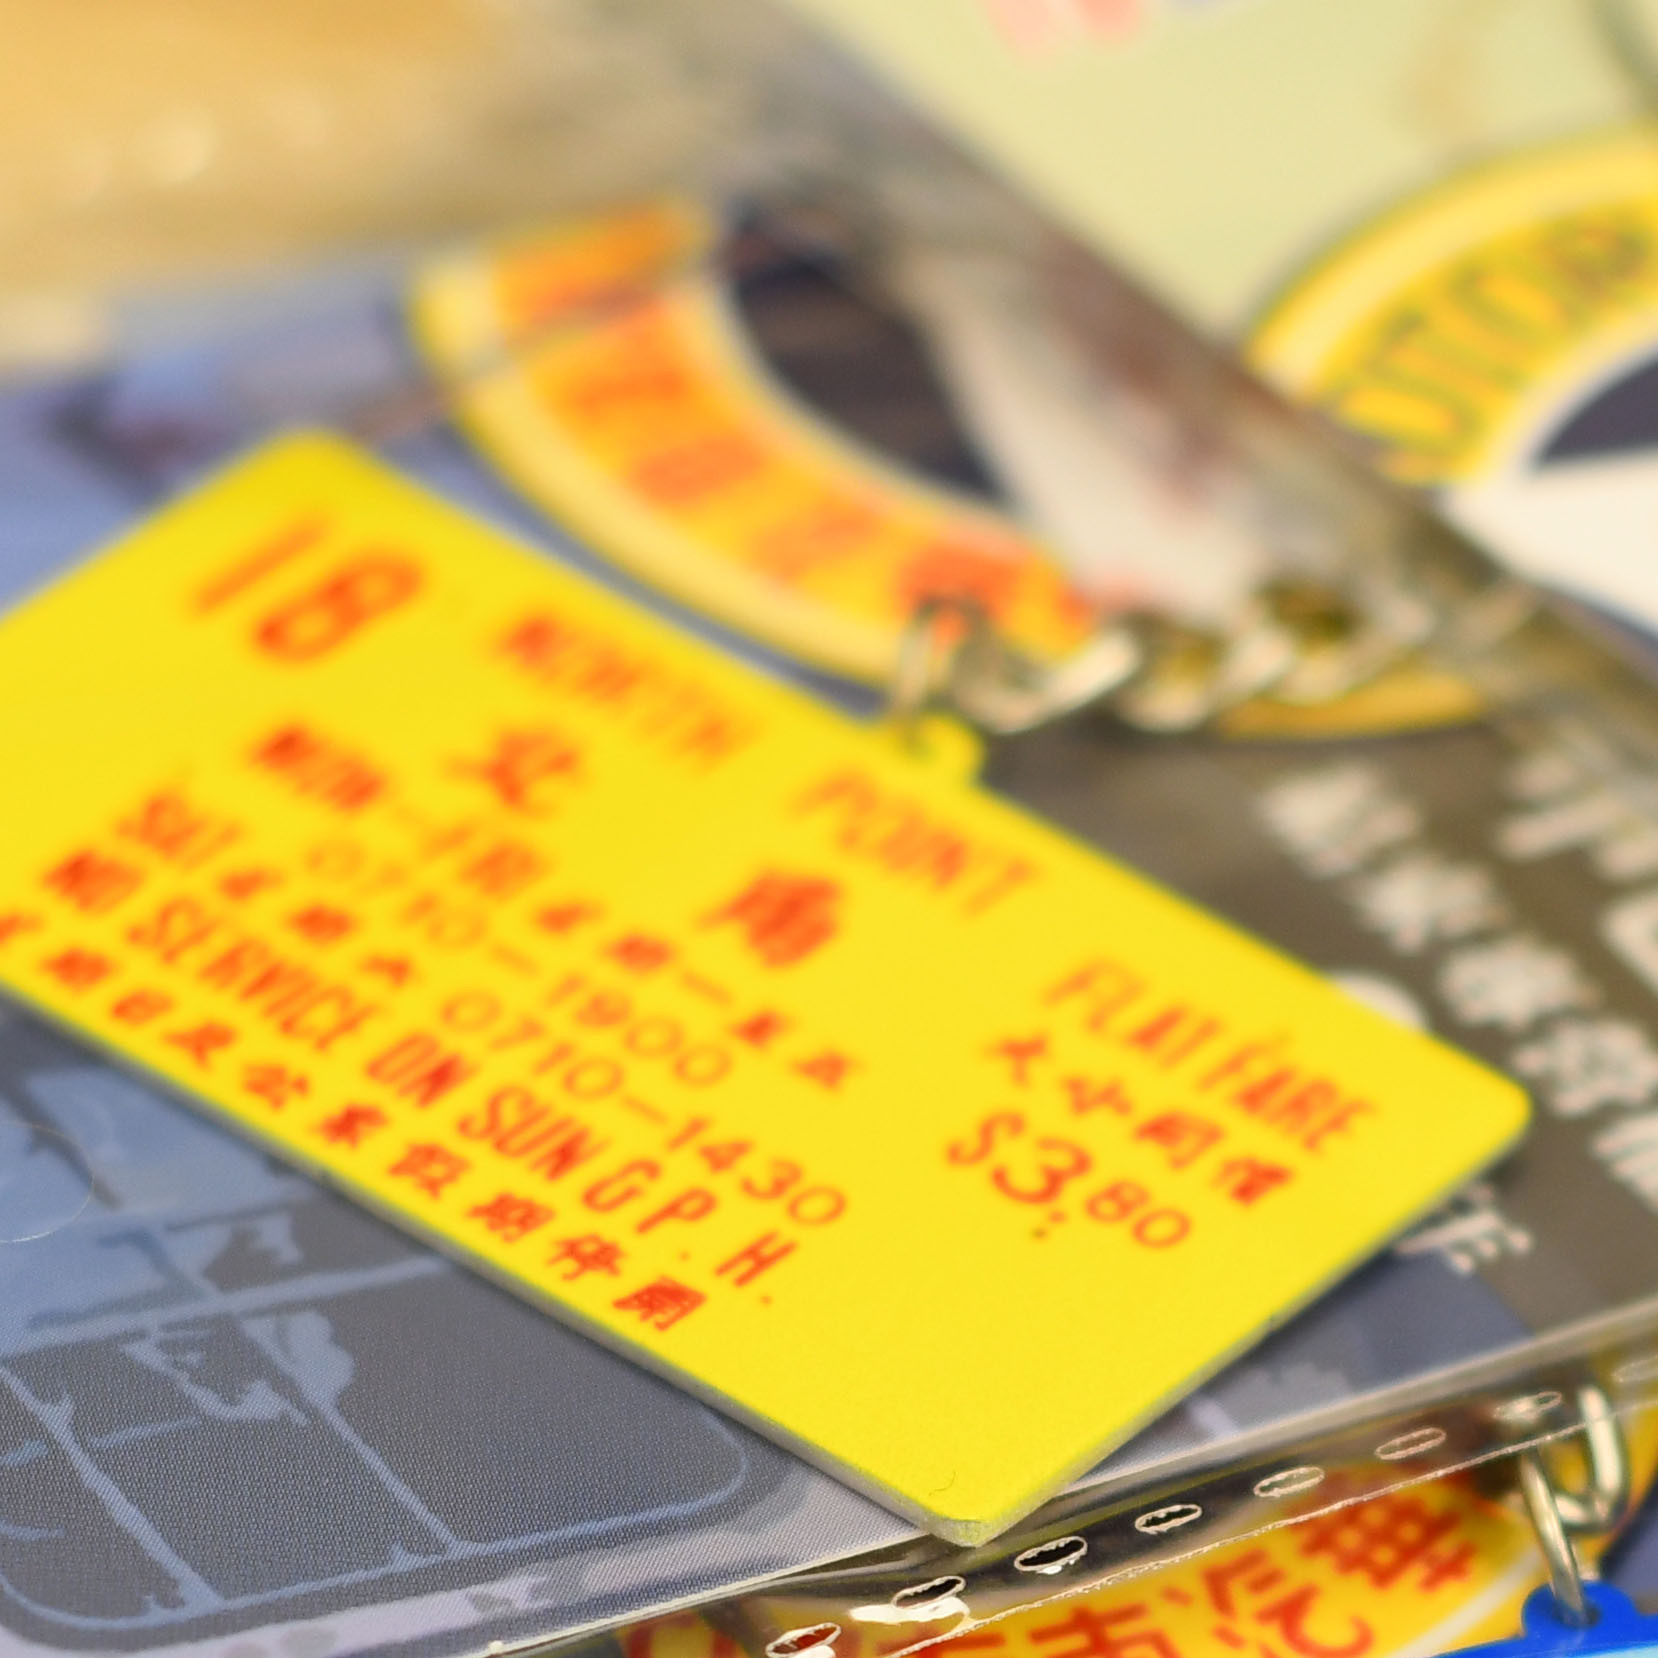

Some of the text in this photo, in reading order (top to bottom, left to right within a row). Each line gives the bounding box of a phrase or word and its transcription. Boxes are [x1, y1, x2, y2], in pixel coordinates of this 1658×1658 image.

[190, 510, 428, 668] 18
[797, 767, 1037, 912] POINT
[122, 894, 379, 1055] SERVICE
[363, 1031, 472, 1111] ON
[454, 1085, 599, 1185] SUN
[434, 989, 851, 1230] 0710-1430
[1046, 961, 1224, 1070] FLAT
[1199, 1042, 1369, 1155] FARE
